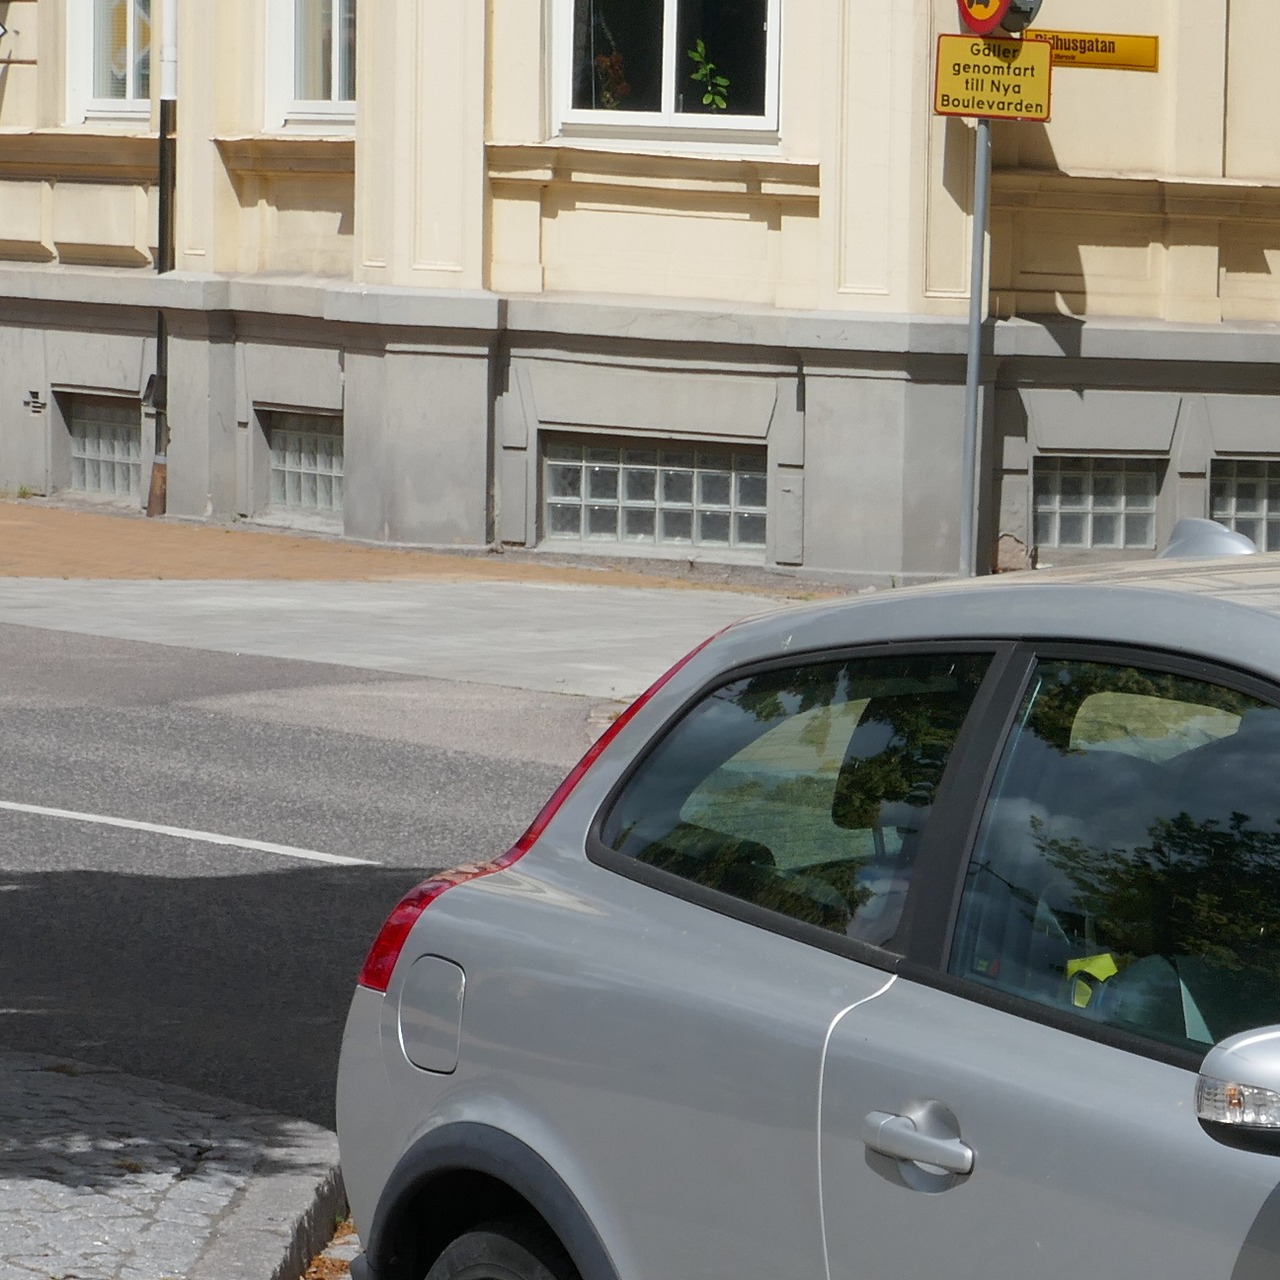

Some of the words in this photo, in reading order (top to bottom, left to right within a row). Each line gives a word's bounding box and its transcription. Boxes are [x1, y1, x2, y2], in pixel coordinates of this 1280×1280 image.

[970, 43, 1018, 58] Gäller
[952, 62, 1035, 77] genomfart
[965, 78, 984, 92] till
[990, 80, 1021, 96] Nya
[941, 94, 1043, 113] Boulevarden
